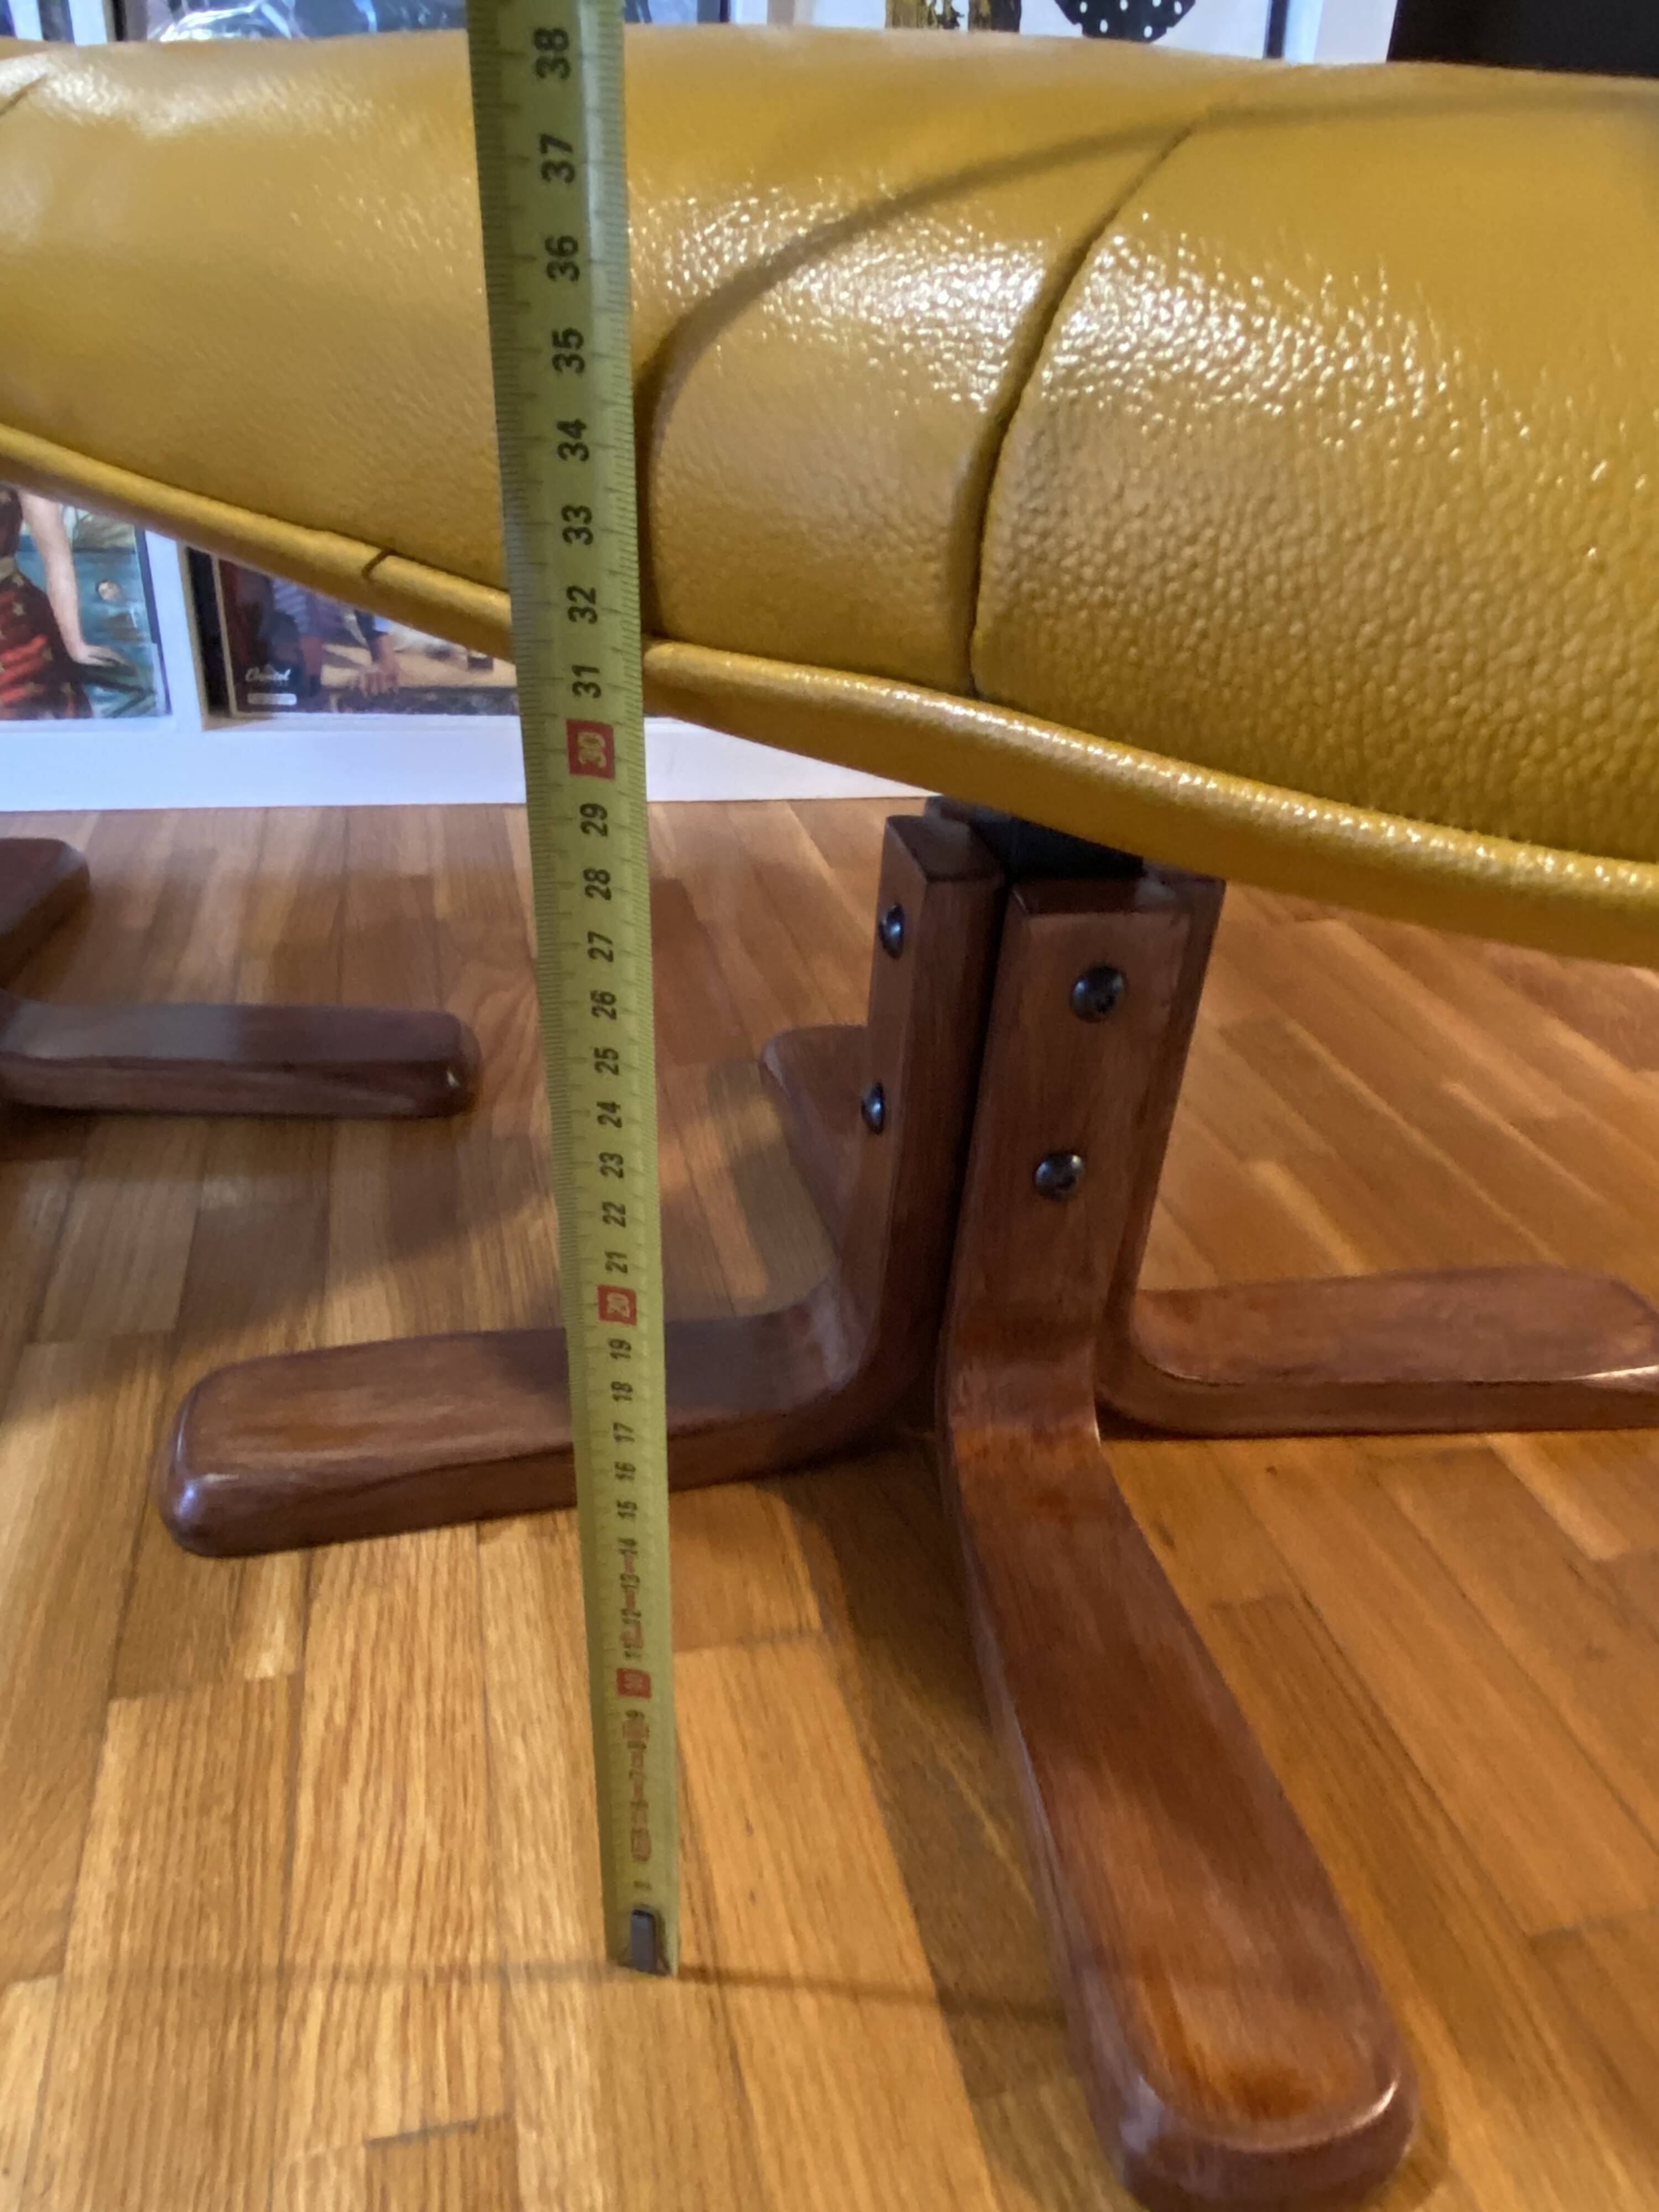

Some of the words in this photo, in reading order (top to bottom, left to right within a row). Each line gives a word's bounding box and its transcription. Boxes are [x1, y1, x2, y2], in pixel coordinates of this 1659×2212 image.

[533, 27, 571, 80] 38
[539, 133, 576, 184] 37
[545, 235, 580, 283] 36
[551, 327, 585, 374] 35
[557, 419, 589, 462] 34
[561, 505, 593, 545] 33
[566, 586, 598, 624] 32
[572, 665, 601, 698] 31
[577, 732, 607, 769] 30
[580, 803, 607, 837] 29
[583, 868, 612, 901] 28
[587, 931, 614, 963] 27
[590, 990, 617, 1020] 26
[593, 1047, 619, 1076] 25
[596, 1100, 622, 1128] 24
[598, 1152, 624, 1179] 23
[602, 1201, 626, 1228] 22
[604, 1251, 628, 1274] 21
[608, 1338, 632, 1360] 19
[611, 1381, 633, 1402] 18
[613, 1422, 635, 1442] 17
